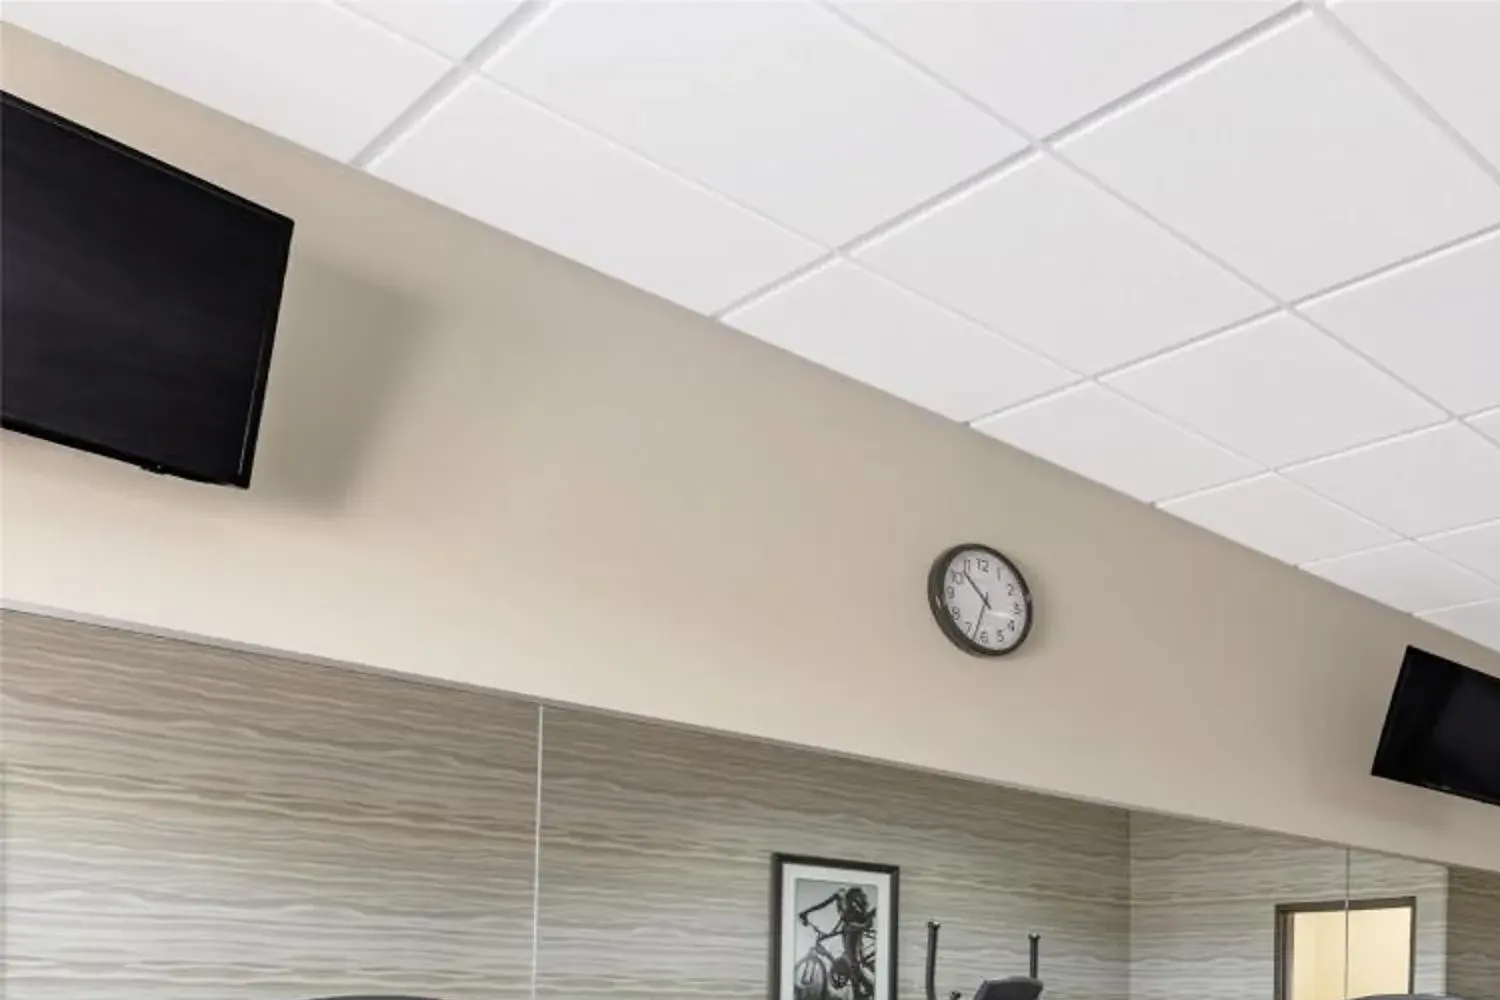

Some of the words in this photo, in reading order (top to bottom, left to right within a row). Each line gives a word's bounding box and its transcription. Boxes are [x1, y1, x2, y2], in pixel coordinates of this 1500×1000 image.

[976, 558, 989, 573] 12
[1007, 583, 1014, 596] 2
[996, 629, 1004, 643] 5
